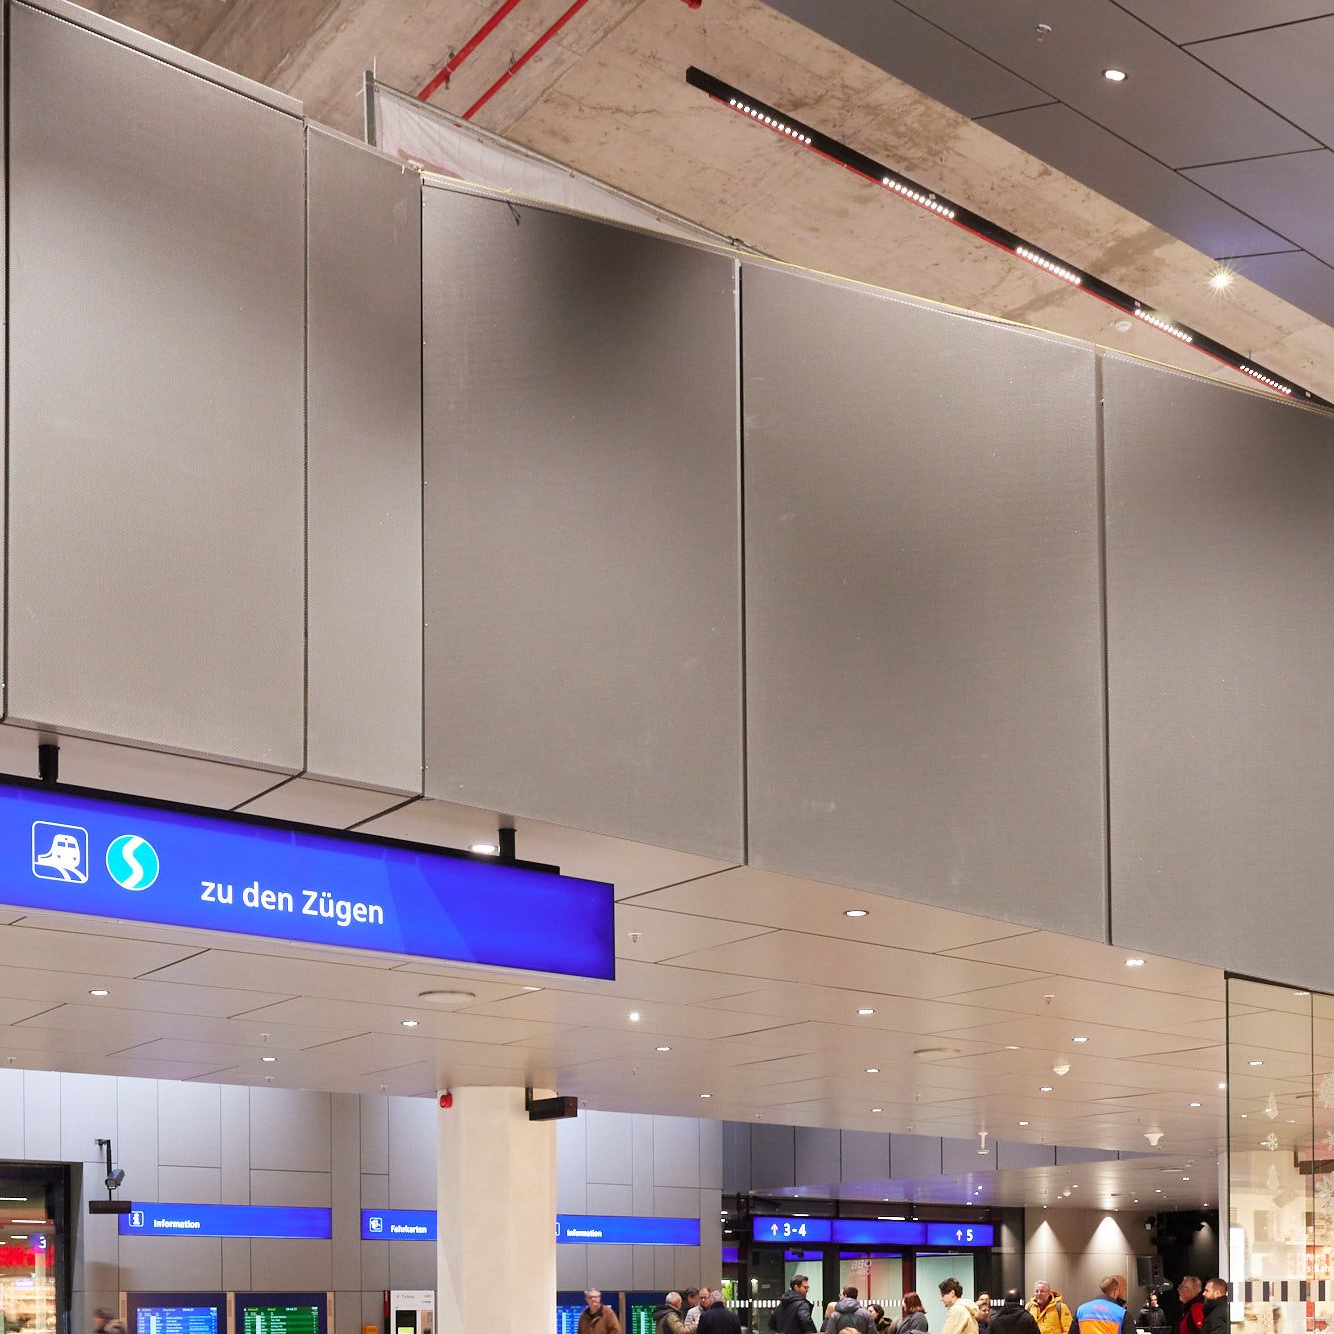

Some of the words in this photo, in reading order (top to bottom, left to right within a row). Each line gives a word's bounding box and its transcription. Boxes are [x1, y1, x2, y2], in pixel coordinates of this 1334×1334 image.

[200, 880, 233, 904] zu
[242, 881, 293, 912] den
[301, 890, 384, 927] Zügen
[153, 1219, 201, 1229] Information
[390, 1224, 428, 1234] Fahrkarten
[783, 1223, 807, 1237] 3-4
[566, 1229, 603, 1238] Information
[966, 1228, 974, 1242] 5
[38, 1235, 47, 1249] 3
